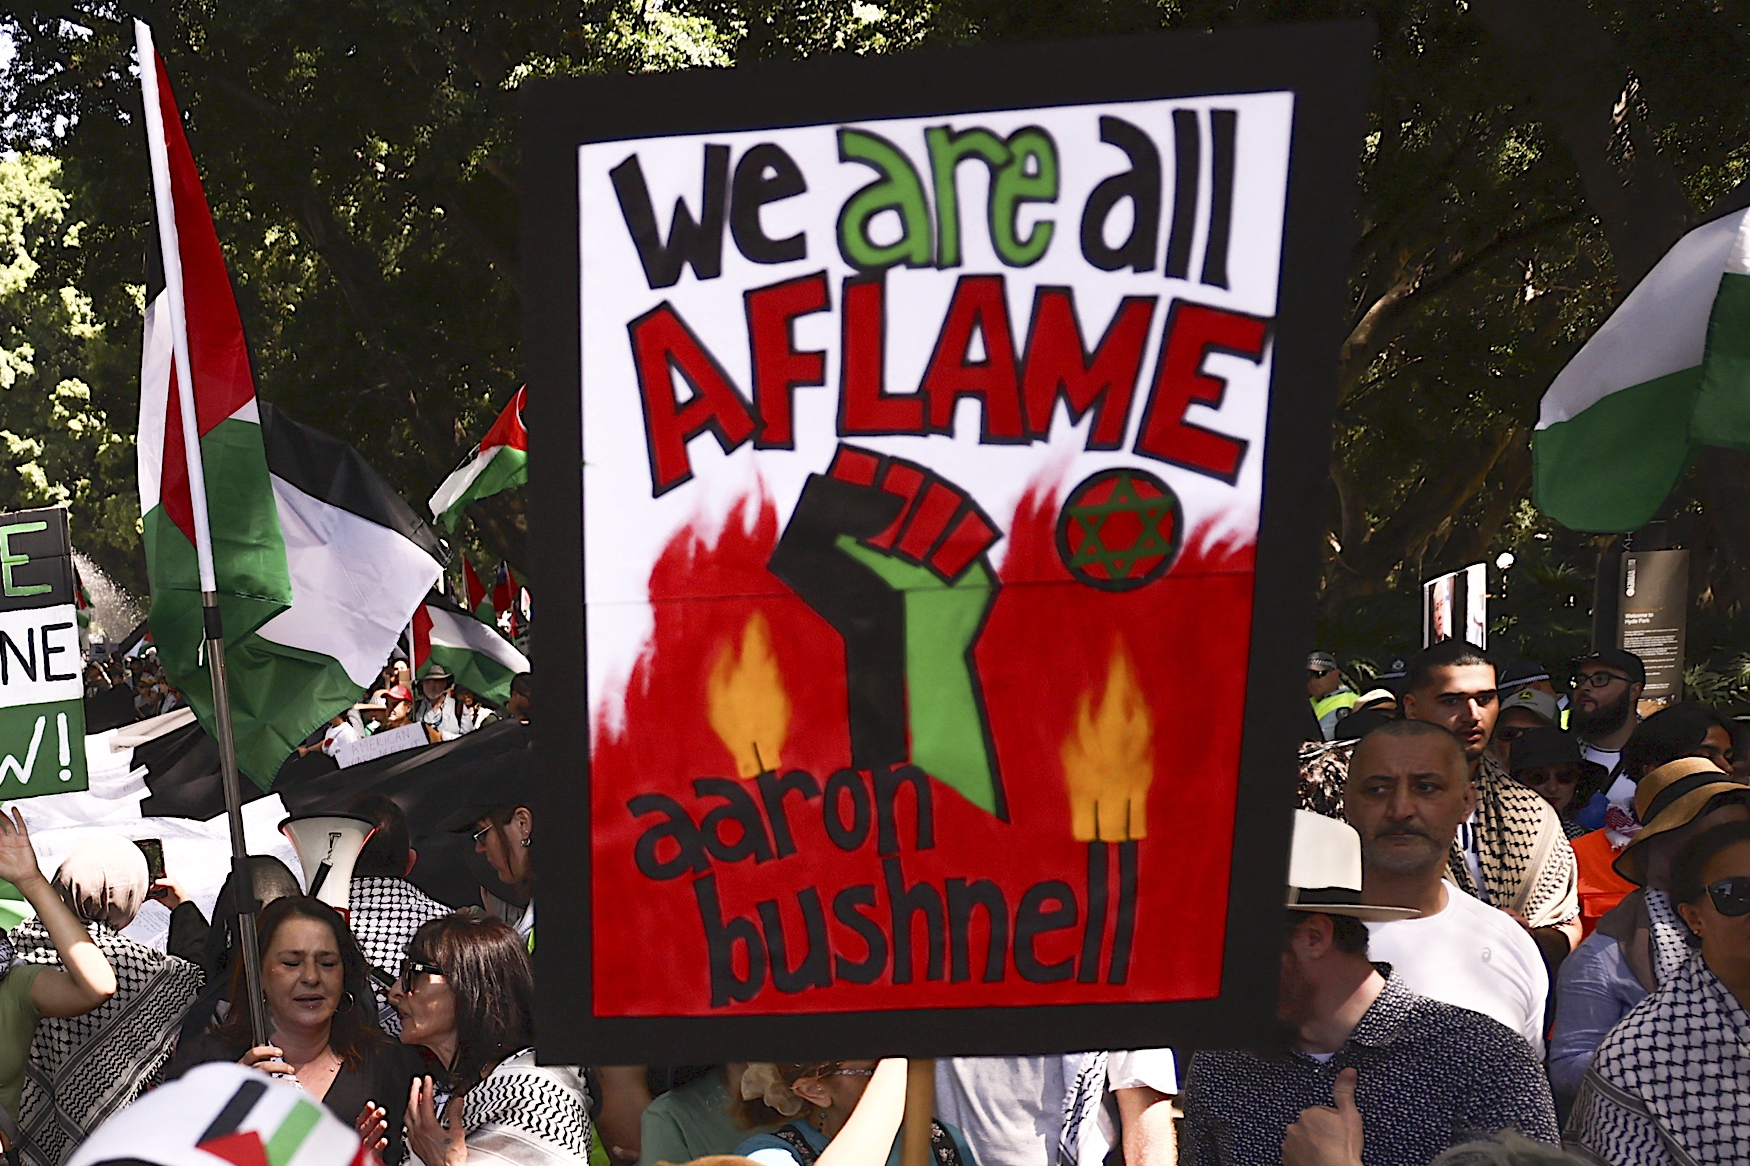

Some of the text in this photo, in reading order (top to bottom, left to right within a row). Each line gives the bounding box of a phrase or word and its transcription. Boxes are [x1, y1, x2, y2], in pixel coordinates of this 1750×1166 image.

[836, 123, 1059, 272] are
[1080, 108, 1239, 289] all
[627, 268, 1276, 497] AFLAME
[351, 728, 410, 755] AMERICAN
[629, 759, 937, 883] aaron
[694, 837, 1138, 1009] bushnell
